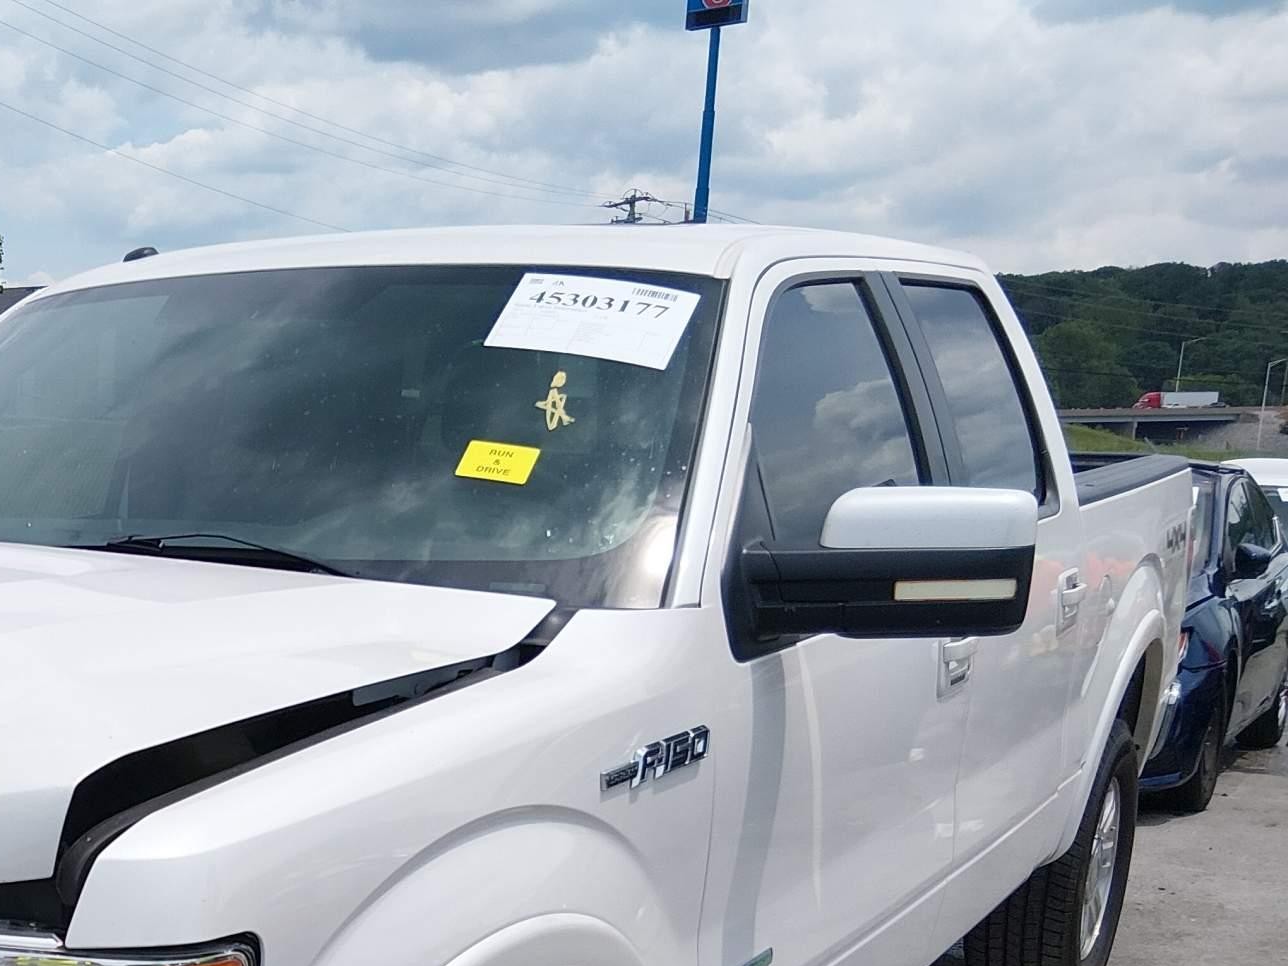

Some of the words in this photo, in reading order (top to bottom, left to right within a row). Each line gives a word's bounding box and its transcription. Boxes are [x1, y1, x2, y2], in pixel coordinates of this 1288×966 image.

[528, 290, 670, 319] 45303177
[489, 448, 514, 458] RUN
[475, 465, 511, 476] DRIVE
